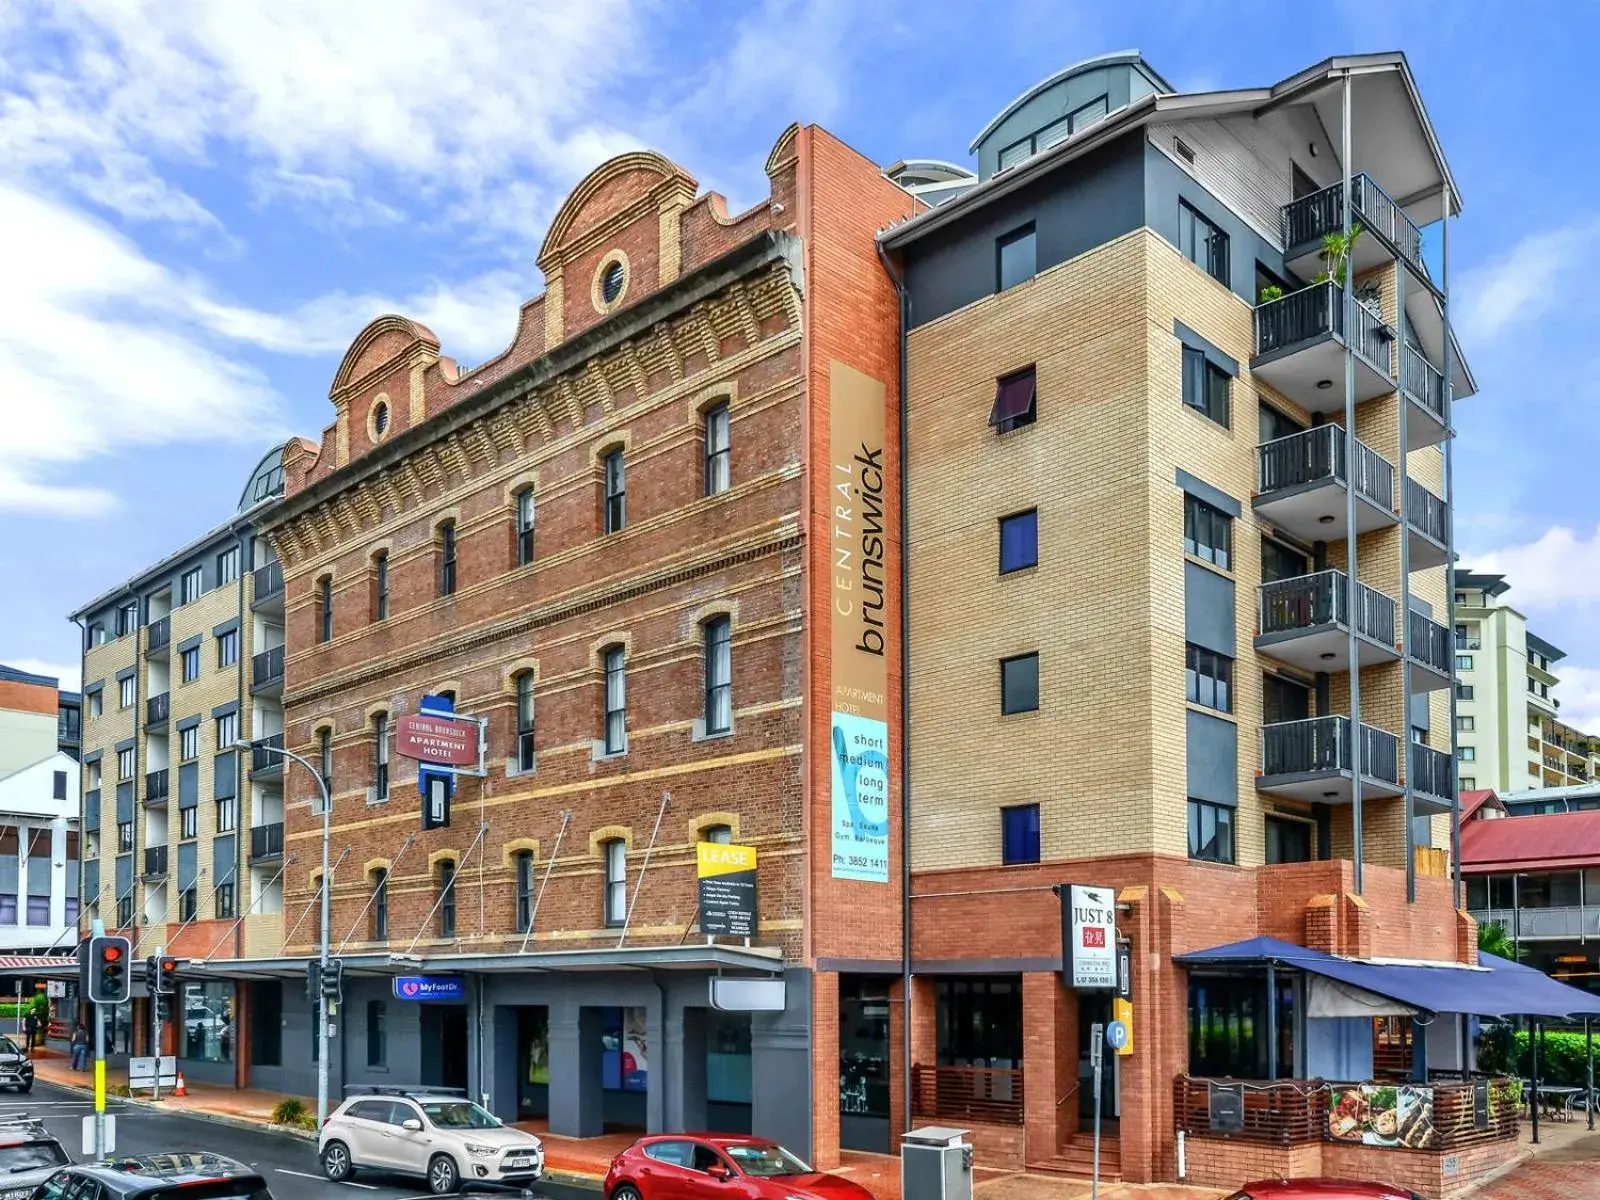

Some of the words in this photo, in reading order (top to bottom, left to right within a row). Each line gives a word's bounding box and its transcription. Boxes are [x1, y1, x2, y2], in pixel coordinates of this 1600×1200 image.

[836, 463, 853, 616] CENTRAL
[854, 441, 884, 657] brunswick
[410, 735, 466, 750] APARTMENT
[854, 734, 883, 750] short
[423, 747, 452, 758] HOTEL
[839, 753, 884, 770] medium
[859, 774, 883, 792] long
[858, 792, 884, 806] term
[702, 848, 748, 866] LEASE
[848, 855, 868, 868] 3852
[870, 858, 888, 870] 1411
[1074, 907, 1104, 926] JUST
[1106, 910, 1114, 925] 8
[1115, 1026, 1124, 1045] P
